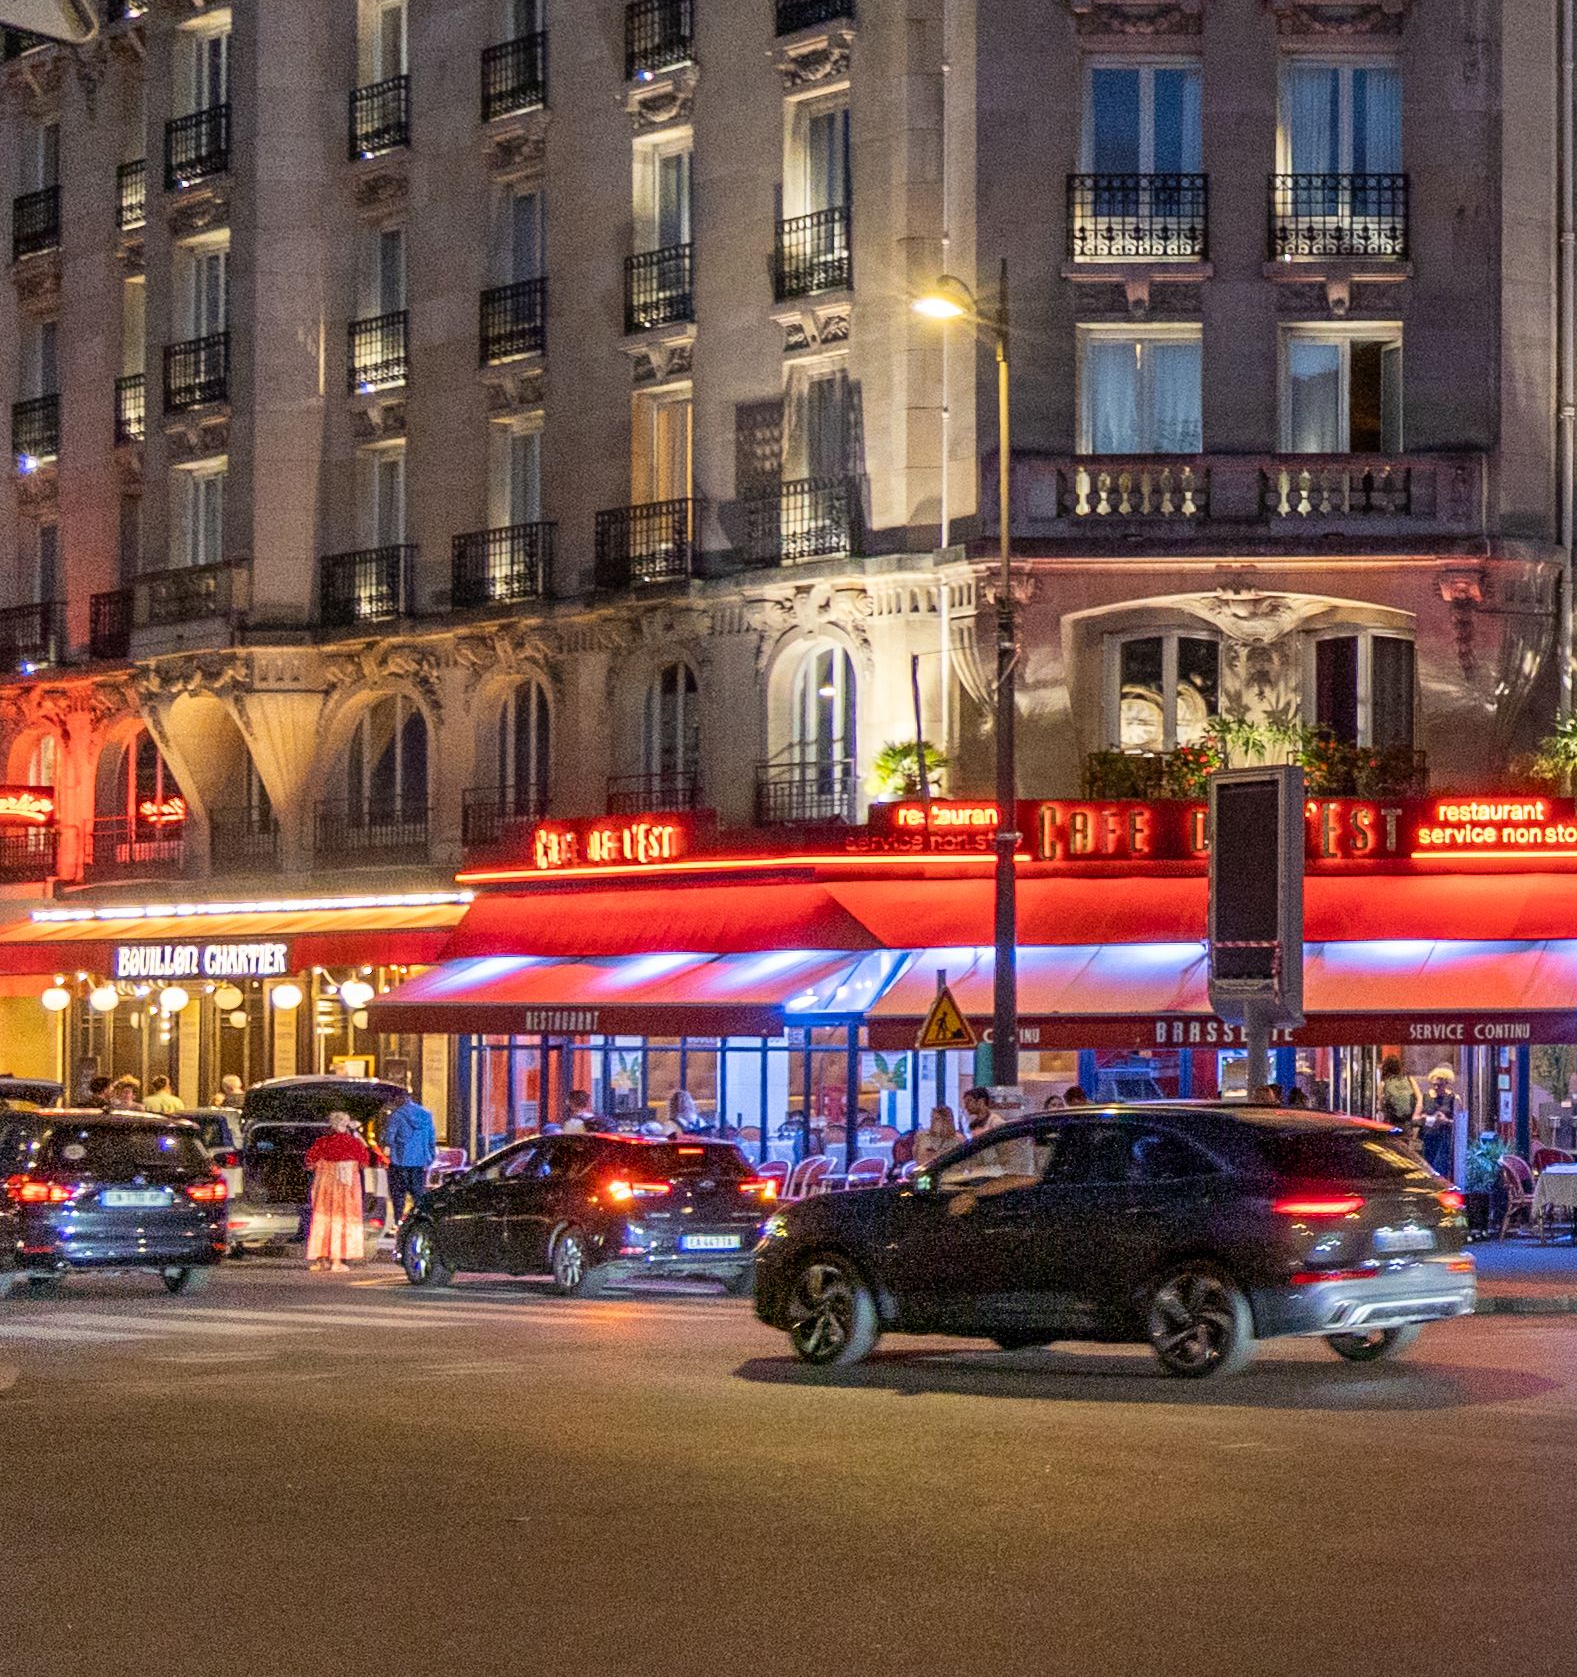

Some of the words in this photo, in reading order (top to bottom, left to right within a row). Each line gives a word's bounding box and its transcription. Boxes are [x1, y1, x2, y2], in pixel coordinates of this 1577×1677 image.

[898, 805, 998, 825] restauran
[1438, 801, 1545, 822] restaurant
[845, 831, 924, 851] service
[1190, 809, 1209, 853] D
[1304, 801, 1403, 860] 'EST
[1418, 824, 1497, 844] service
[1502, 826, 1543, 844] non
[118, 945, 200, 977] BOUILLON
[203, 942, 288, 975] CHARTIER
[526, 1010, 600, 1031] RESTAURANT
[1409, 1023, 1465, 1040] SERVICE
[1473, 1022, 1531, 1040] CONTINU
[1155, 1021, 1295, 1043] BRASSEIE
